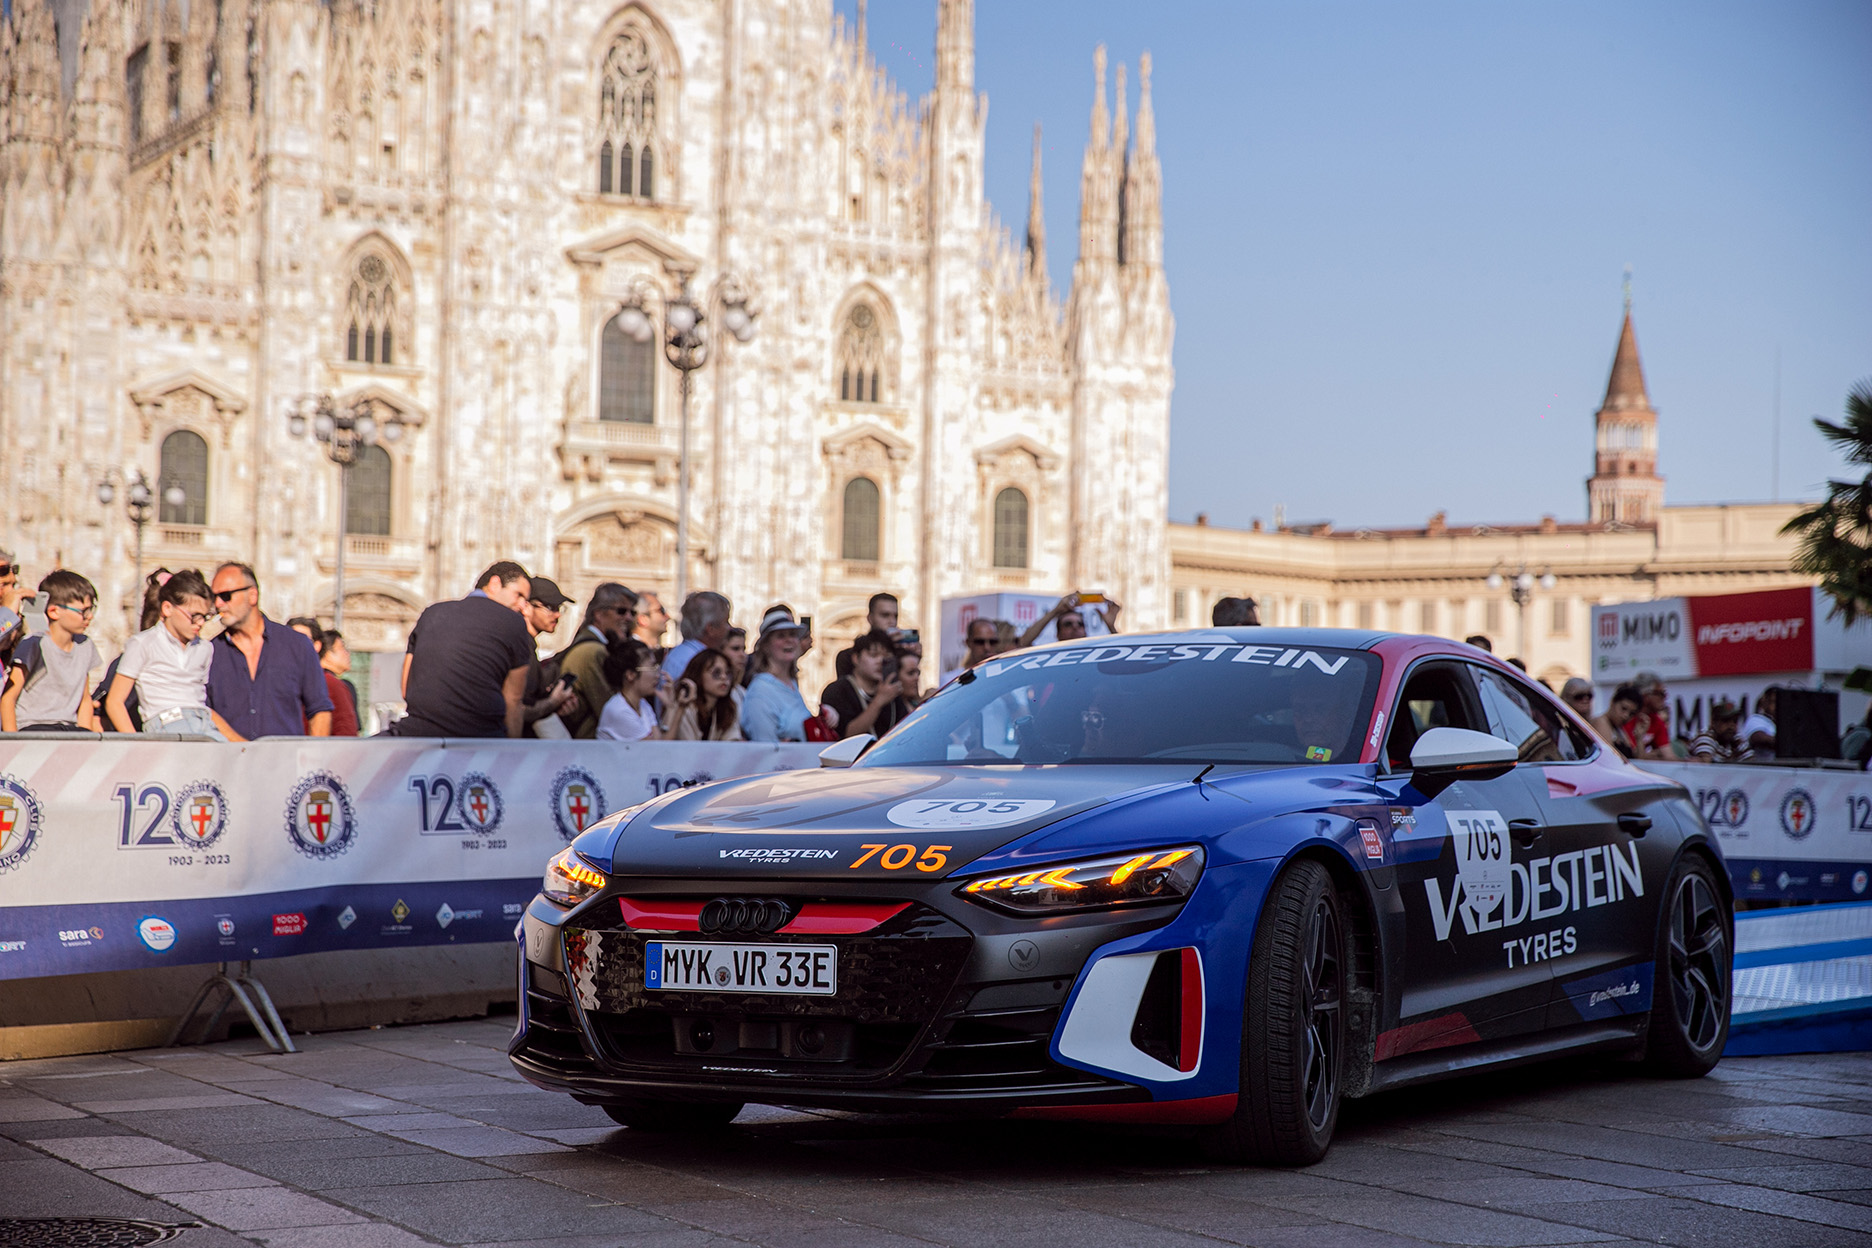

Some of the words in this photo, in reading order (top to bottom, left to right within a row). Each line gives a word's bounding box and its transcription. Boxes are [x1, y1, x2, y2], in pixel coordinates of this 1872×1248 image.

[1622, 611, 1680, 645] MIMO
[1697, 617, 1804, 645] INFOPOINT
[986, 644, 1350, 677] VREDESTEIN
[916, 801, 1025, 814] 705
[1391, 815, 1416, 824] SPORTS
[1458, 819, 1501, 861] 705
[168, 856, 193, 866] 1903
[205, 854, 231, 865] 2023
[720, 848, 839, 859] VREDESTEIN
[849, 844, 953, 872] 705
[276, 915, 300, 924] 1000
[58, 929, 90, 942] sara
[274, 925, 302, 935] MIGLIA
[1503, 926, 1577, 969] TYRES
[664, 948, 713, 985] MYK
[733, 950, 768, 986] VR
[776, 951, 830, 988] 33E
[651, 970, 658, 980] D
